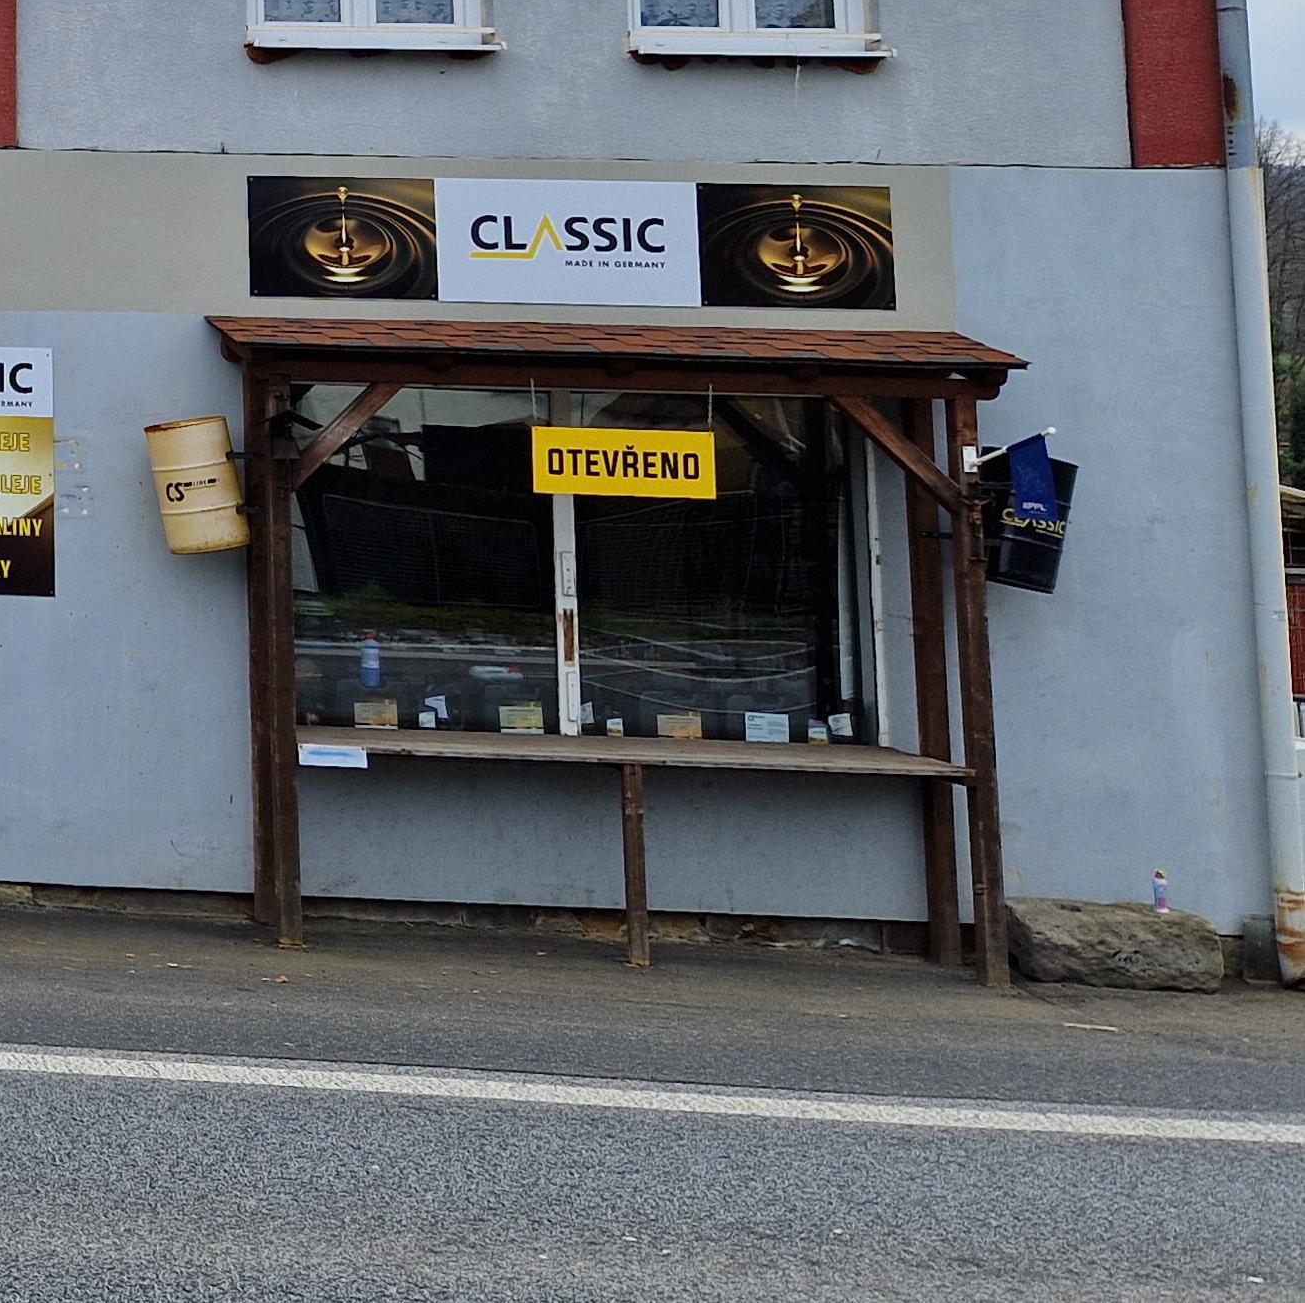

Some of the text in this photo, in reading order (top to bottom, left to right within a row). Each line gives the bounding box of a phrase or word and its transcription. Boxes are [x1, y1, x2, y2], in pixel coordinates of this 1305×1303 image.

[468, 213, 666, 259] CLASSIC
[565, 260, 666, 269] MADE IN GERMANY
[547, 444, 700, 480] OTEVŘENO
[166, 482, 185, 502] CS
